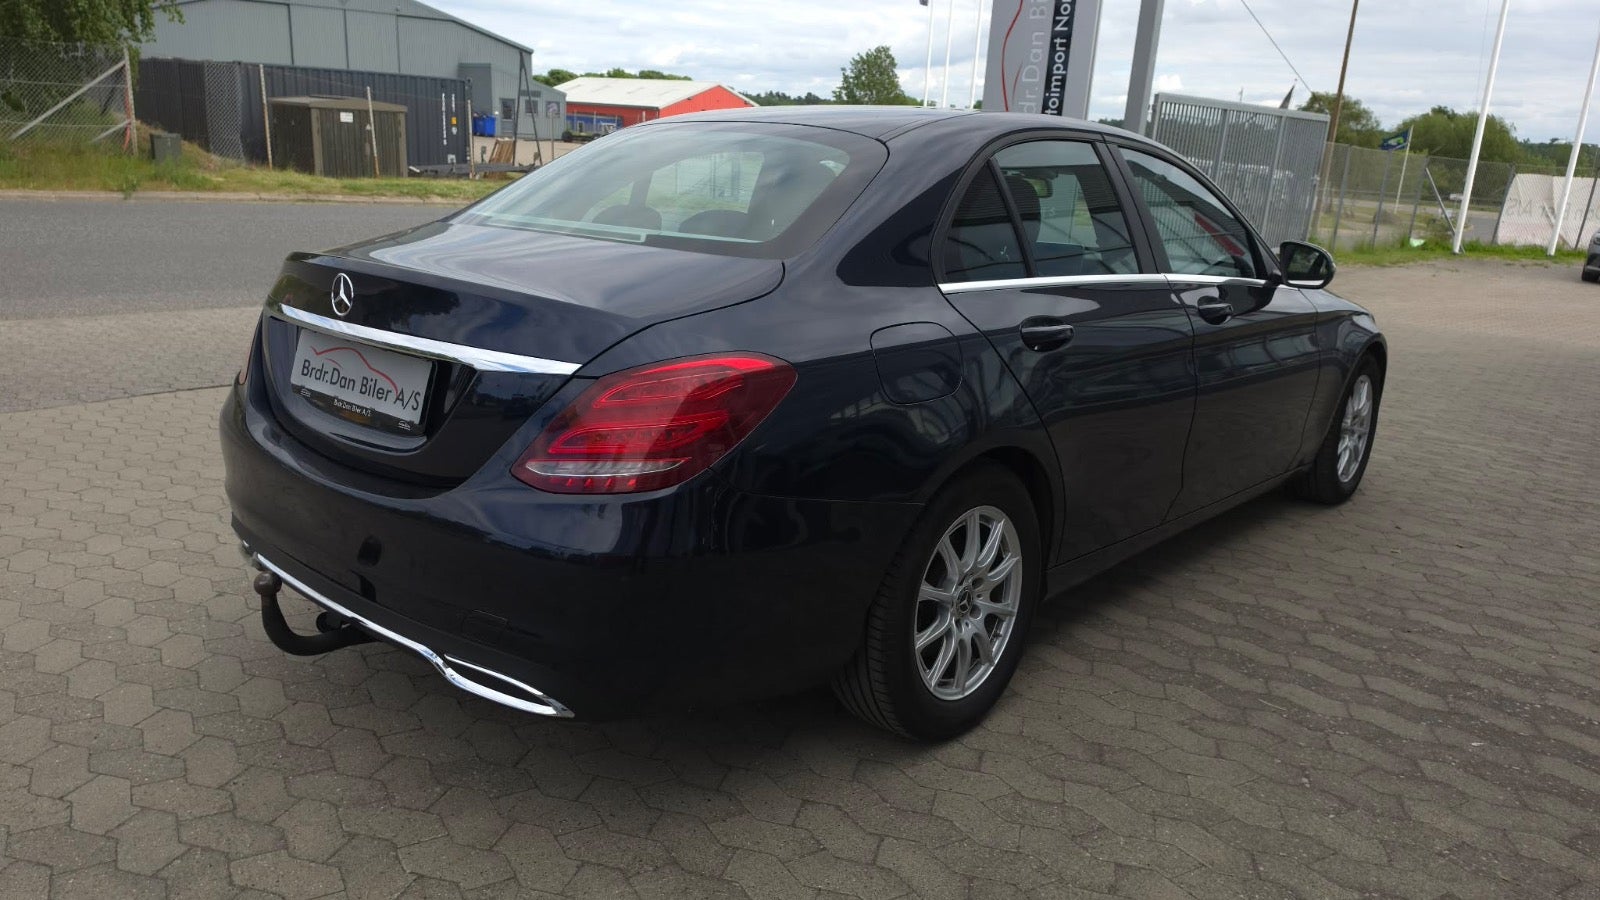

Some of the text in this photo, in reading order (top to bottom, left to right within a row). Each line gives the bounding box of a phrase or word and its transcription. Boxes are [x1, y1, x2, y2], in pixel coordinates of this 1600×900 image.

[301, 359, 421, 412] Brdr.Dan Biler A/S
